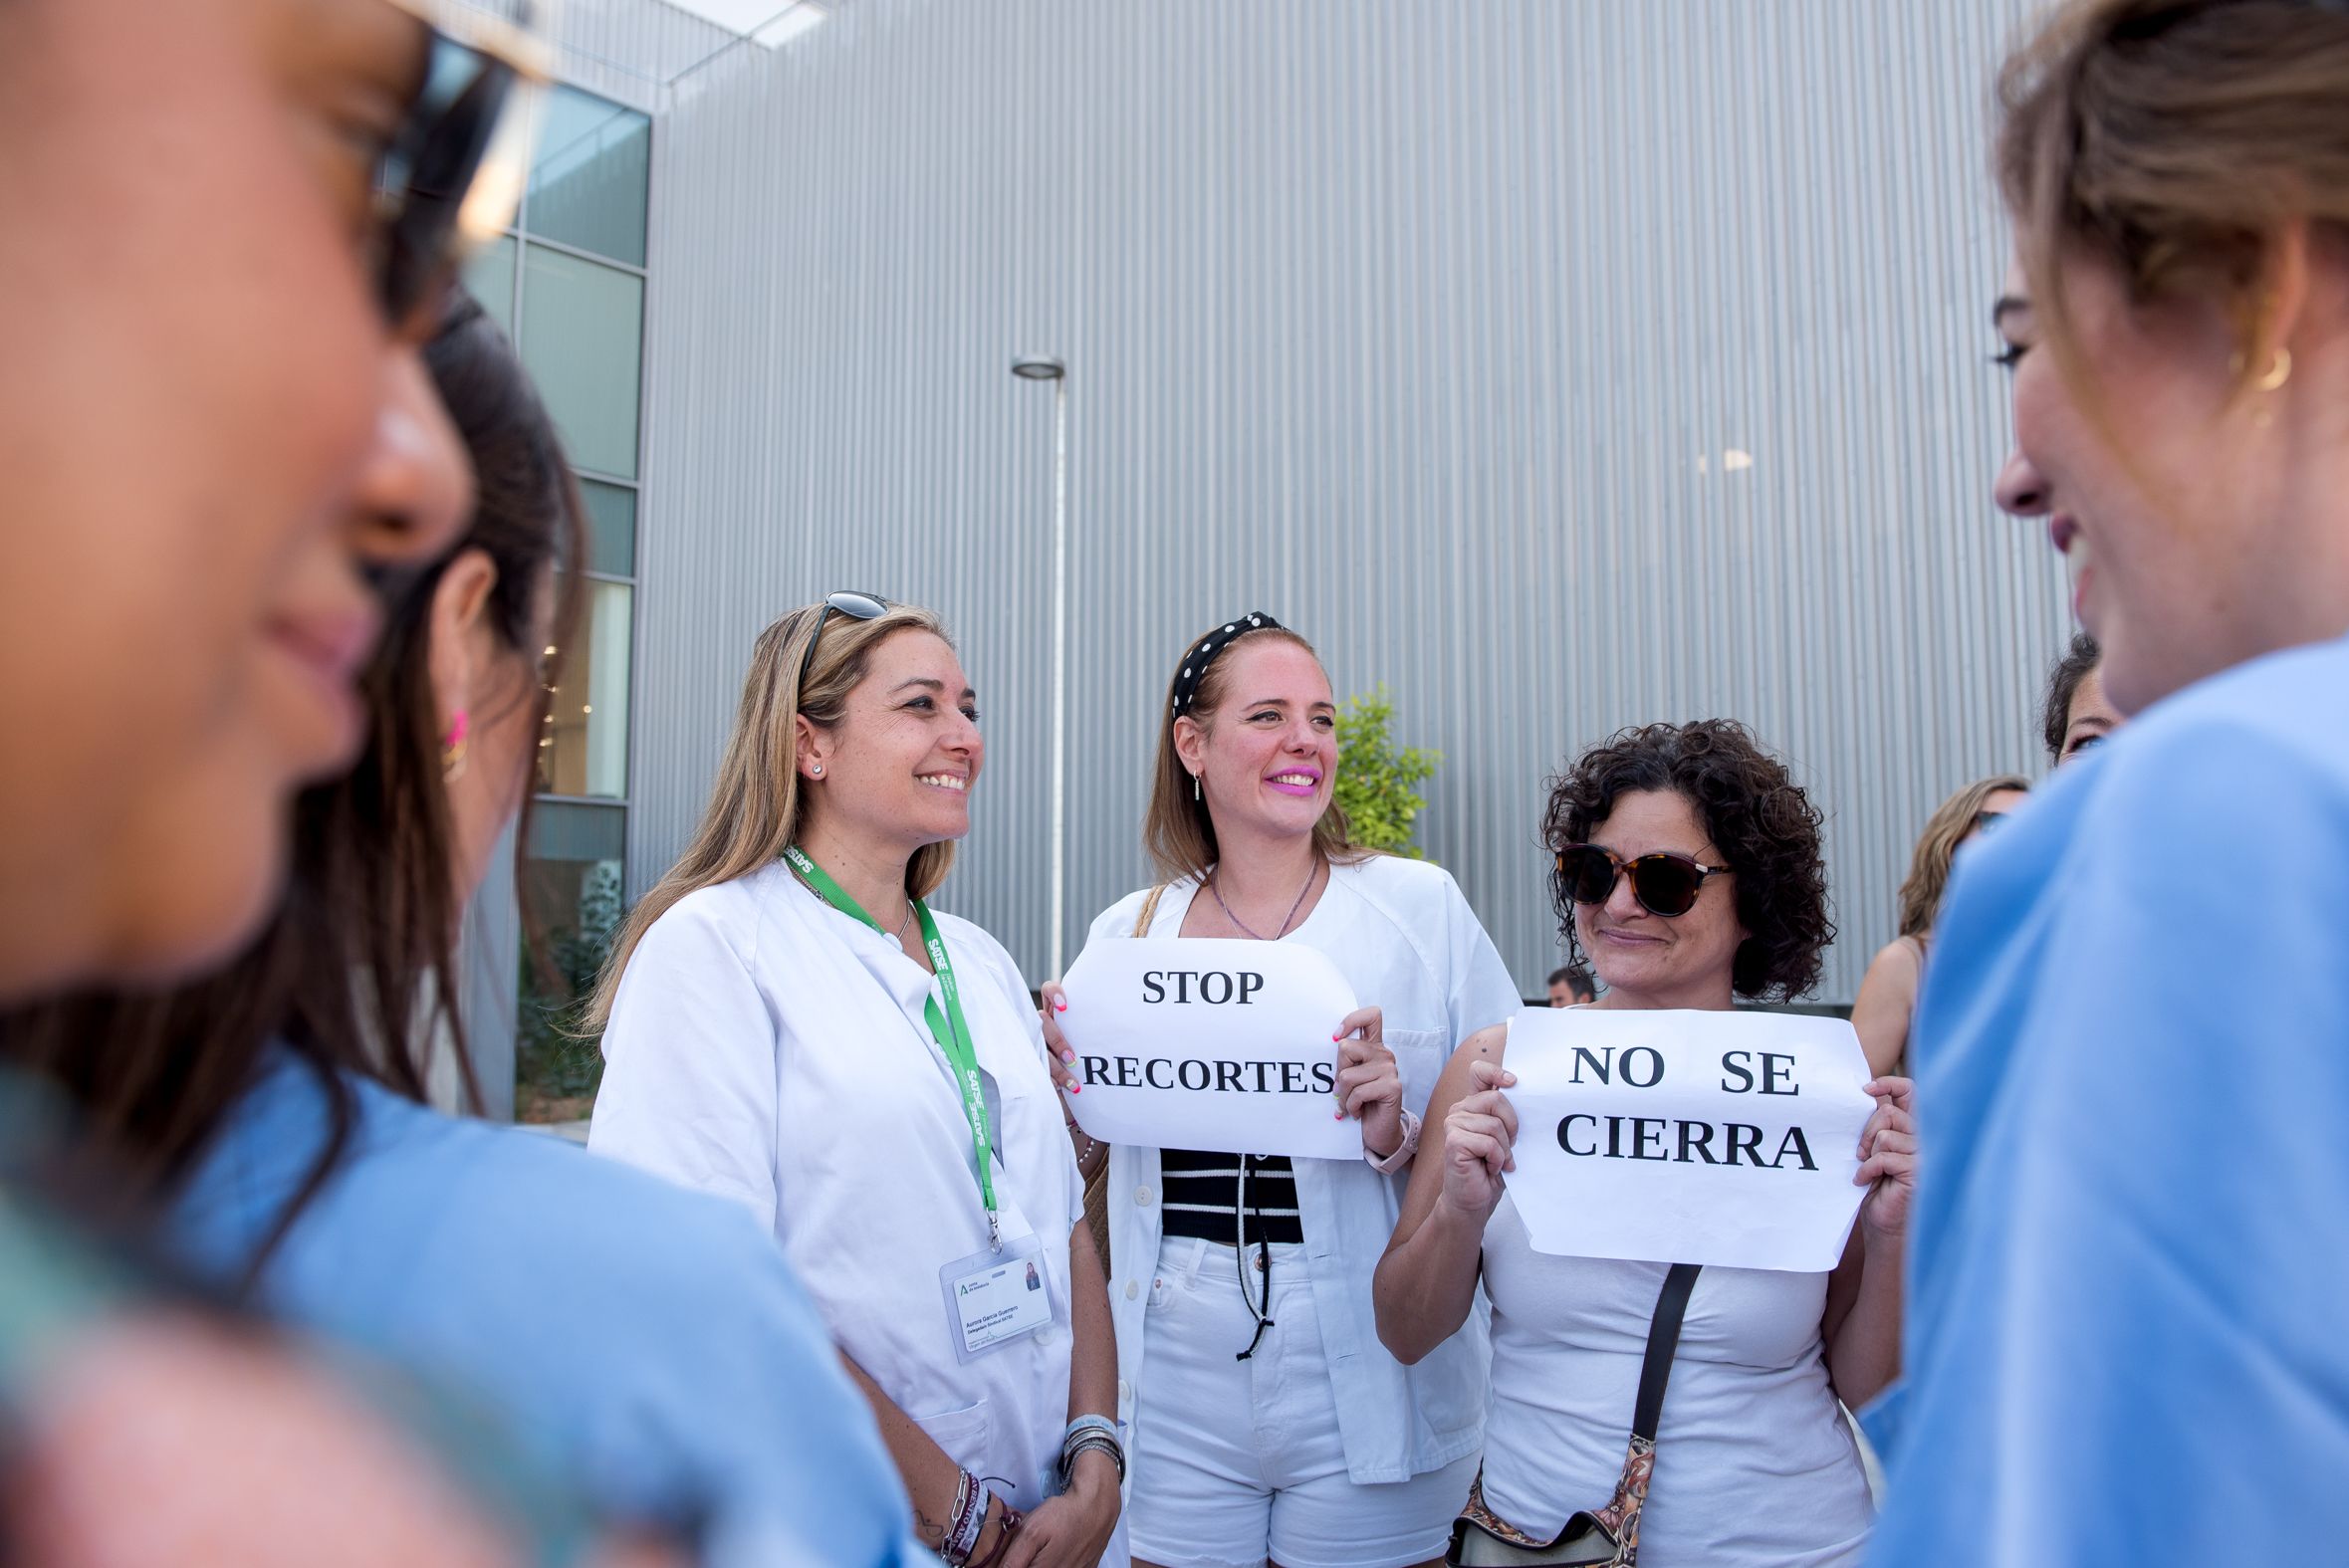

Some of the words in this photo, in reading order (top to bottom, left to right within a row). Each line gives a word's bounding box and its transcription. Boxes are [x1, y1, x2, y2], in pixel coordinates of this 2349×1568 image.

[927, 938, 949, 972] SATSE
[1142, 971, 1265, 1005] STOP
[967, 1069, 985, 1110] SATSE
[1080, 1055, 1335, 1094] RECORTES
[1568, 1046, 1665, 1088] NO
[1721, 1050, 1799, 1096] SE
[968, 1101, 986, 1147] SATSE
[1556, 1113, 1819, 1171] CIERRA
[967, 1319, 982, 1328] Aurora
[998, 1306, 1019, 1316] Guerrero
[963, 1489, 979, 1524] BENITO
